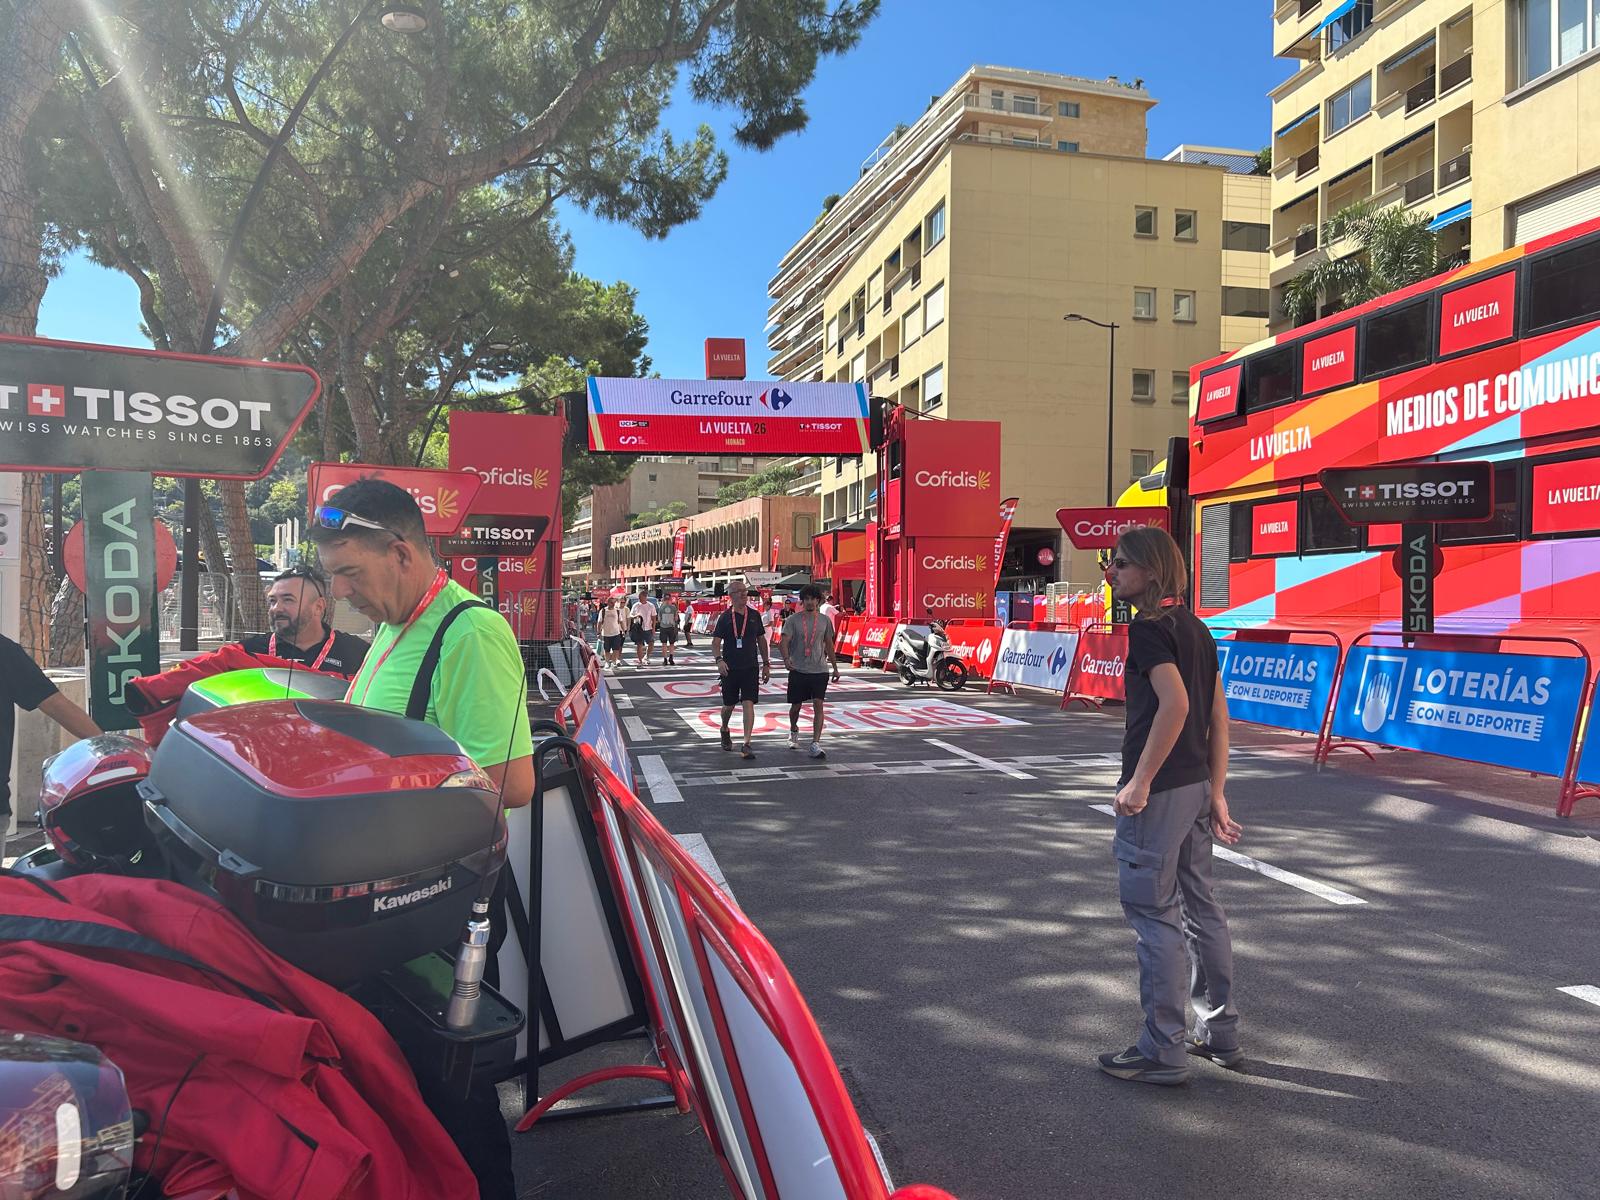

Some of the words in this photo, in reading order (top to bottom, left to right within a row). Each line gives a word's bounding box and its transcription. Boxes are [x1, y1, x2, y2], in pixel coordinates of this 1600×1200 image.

[1453, 312, 1464, 327] LA
[1466, 301, 1499, 323] VUELTA
[1312, 358, 1320, 371] LA
[1321, 350, 1345, 368] VUELTA
[671, 390, 752, 406] Carrefour
[1206, 391, 1213, 402] LA
[1213, 385, 1231, 400] VUELTA
[1386, 386, 1459, 437] MEDIOS
[1463, 379, 1489, 421] DE
[1494, 352, 1600, 413] COMUNIC
[73, 386, 271, 431] TISSOT
[63, 424, 156, 440] WATCHES
[168, 431, 223, 444] SINCE
[234, 435, 272, 447] 1853
[700, 421, 712, 434] LA
[713, 421, 752, 434] VUELTA
[754, 422, 767, 435] 26
[1250, 436, 1264, 461] LA
[1266, 425, 1312, 458] VUELTA
[462, 466, 533, 486] ofidis
[915, 470, 977, 488] Cofidis
[1344, 487, 1356, 498] T
[1378, 480, 1475, 499] TISSOT
[1548, 489, 1561, 505] LA
[1421, 498, 1449, 506] SINCE
[473, 527, 535, 541] TISSOT
[1074, 519, 1146, 537] Cofid
[1260, 523, 1267, 535] LA
[1268, 521, 1288, 533] VUELTA
[461, 557, 524, 573] Cdis
[922, 555, 975, 571] Cofidis
[922, 593, 975, 609] Cofidis
[1002, 647, 1044, 668] Carrefour
[1081, 653, 1124, 677] Carrefo
[1231, 654, 1318, 683] LOTERÍAS
[1232, 685, 1250, 696] CON
[1251, 687, 1261, 698] EL
[1263, 689, 1304, 704] DEPORTE
[1412, 667, 1552, 705] LOTERÍAS
[1416, 707, 1444, 721] CON
[1447, 710, 1461, 725] EL
[1465, 713, 1532, 734] DEPORTE
[373, 876, 452, 912] Kawasaki
